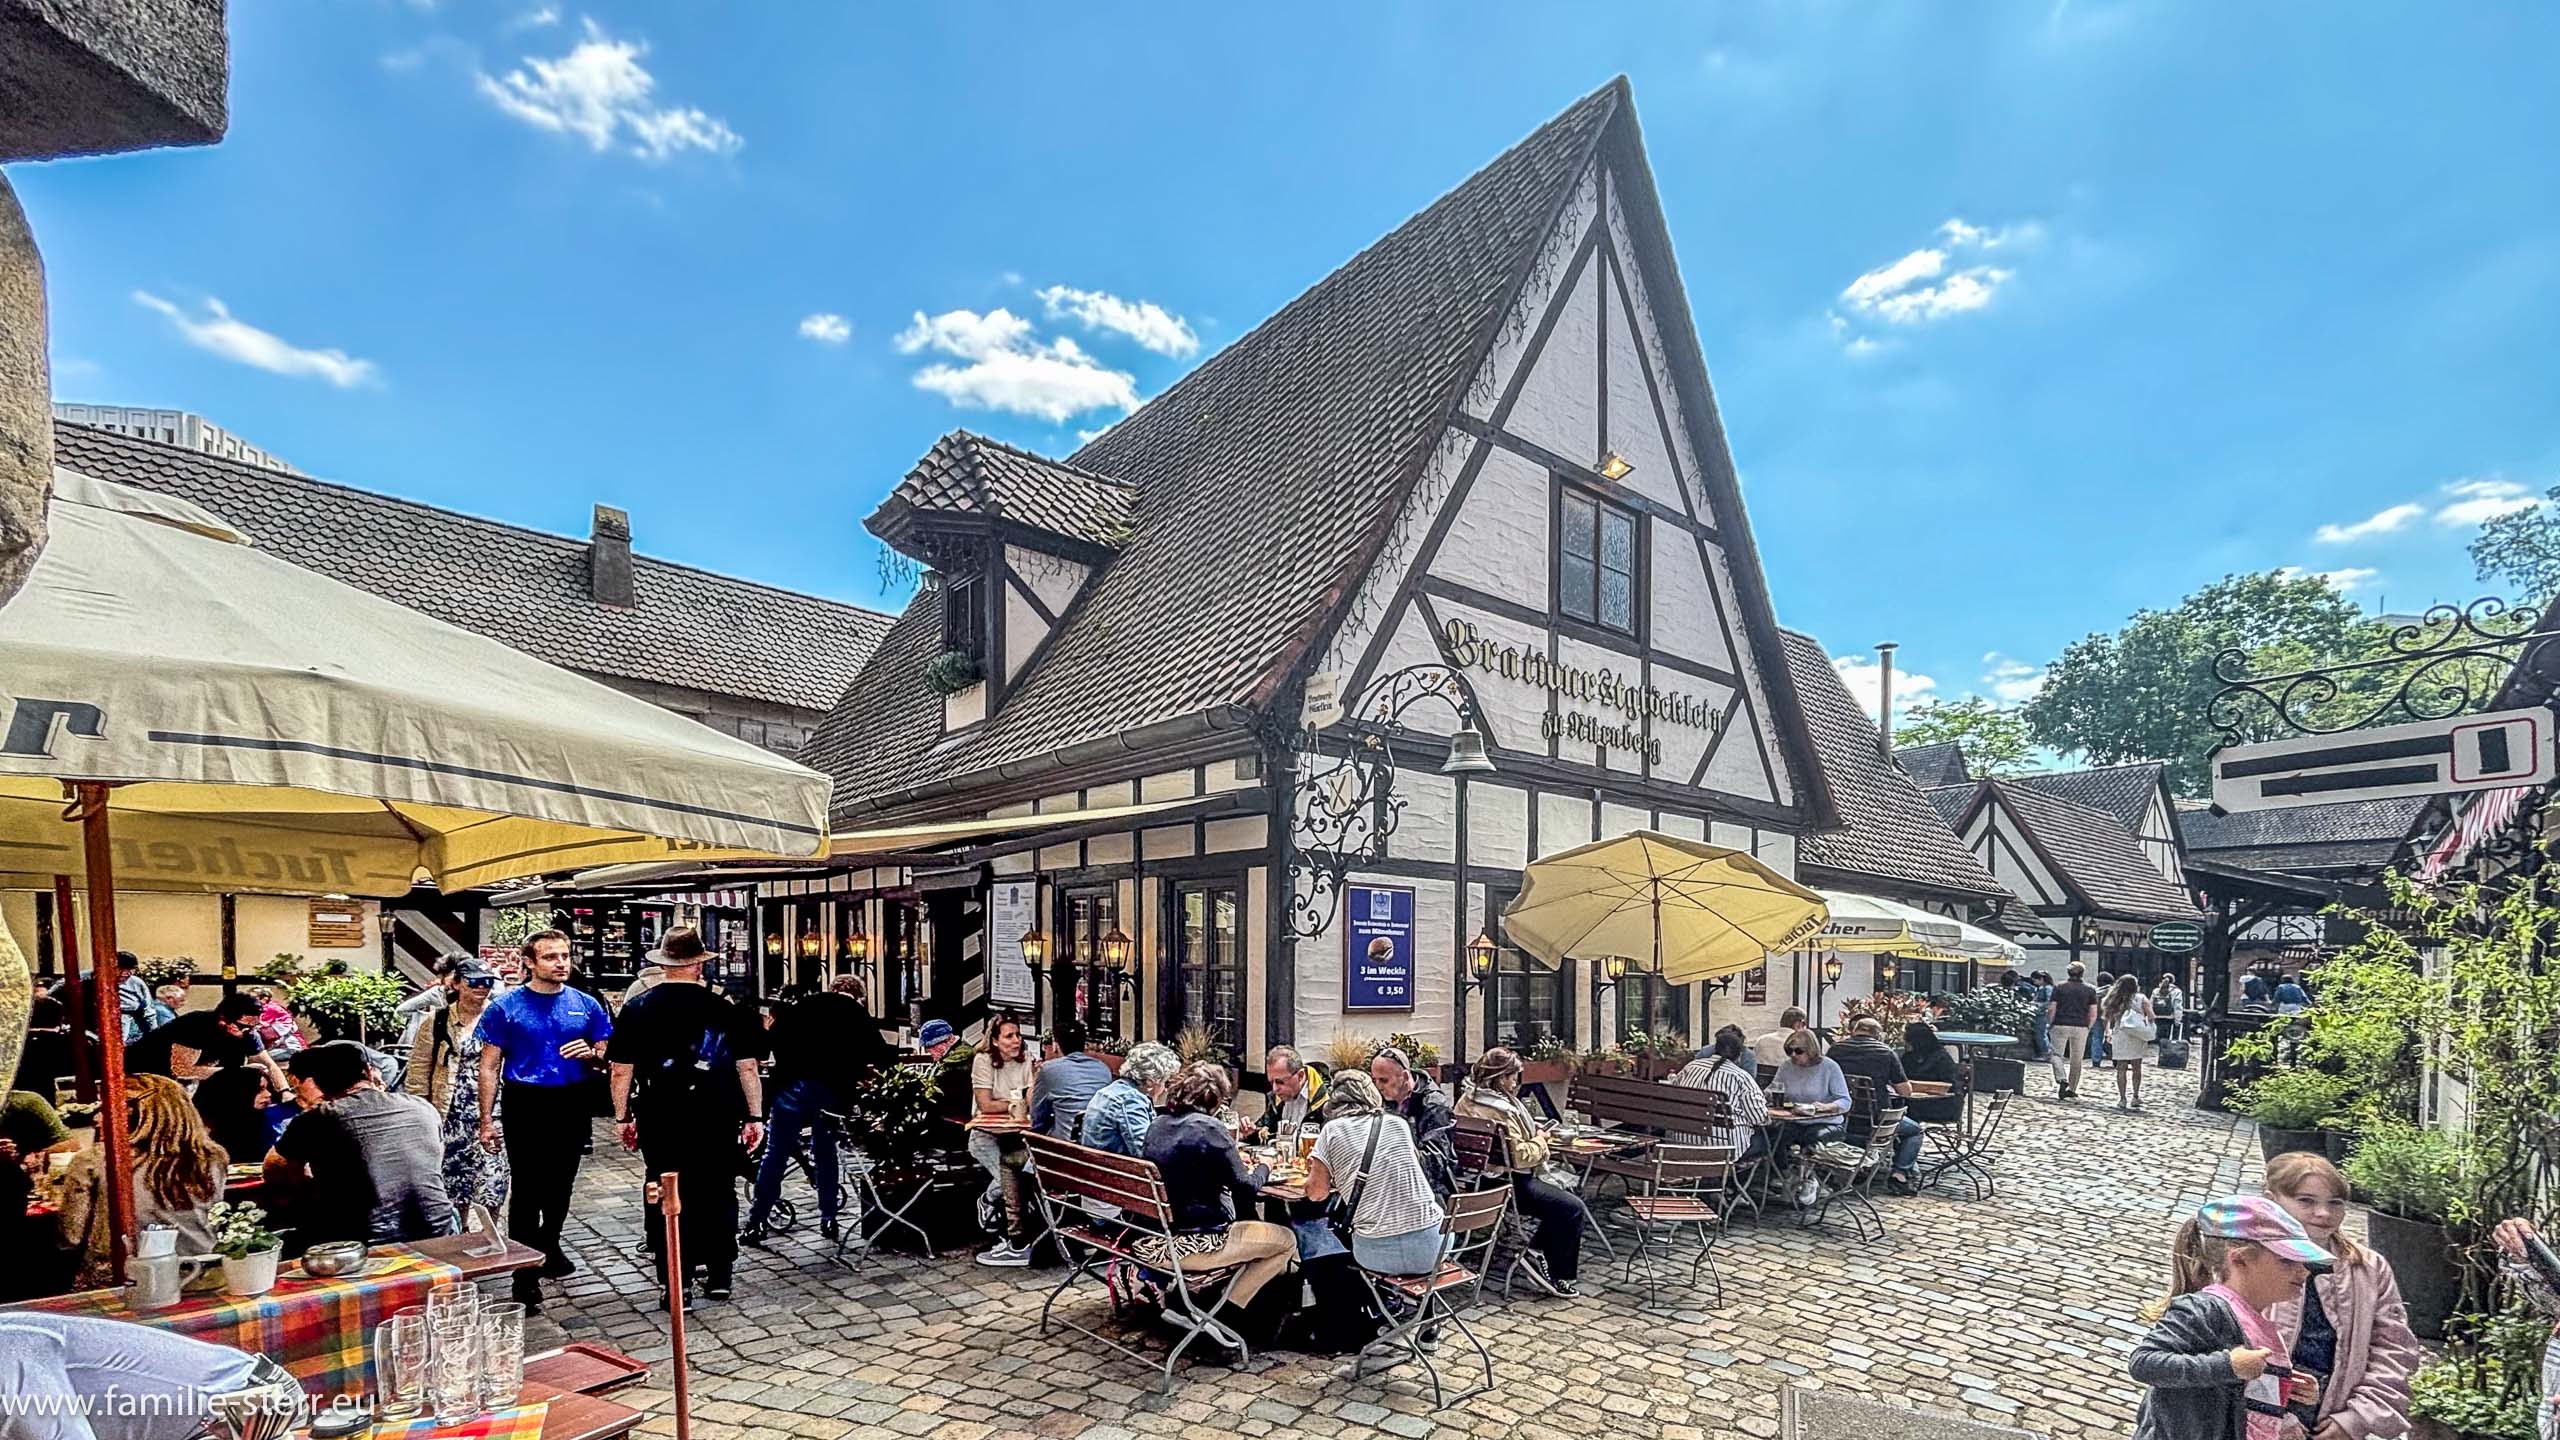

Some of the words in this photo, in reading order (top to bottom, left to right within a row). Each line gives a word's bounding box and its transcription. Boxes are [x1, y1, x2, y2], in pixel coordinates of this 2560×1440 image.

[1542, 710, 1564, 740] zu
[1567, 711, 1661, 766] Nürnberg
[1360, 966, 1366, 975] 3
[1367, 966, 1377, 975] im
[1377, 986, 1384, 995] €
[1386, 986, 1404, 996] 3,50
